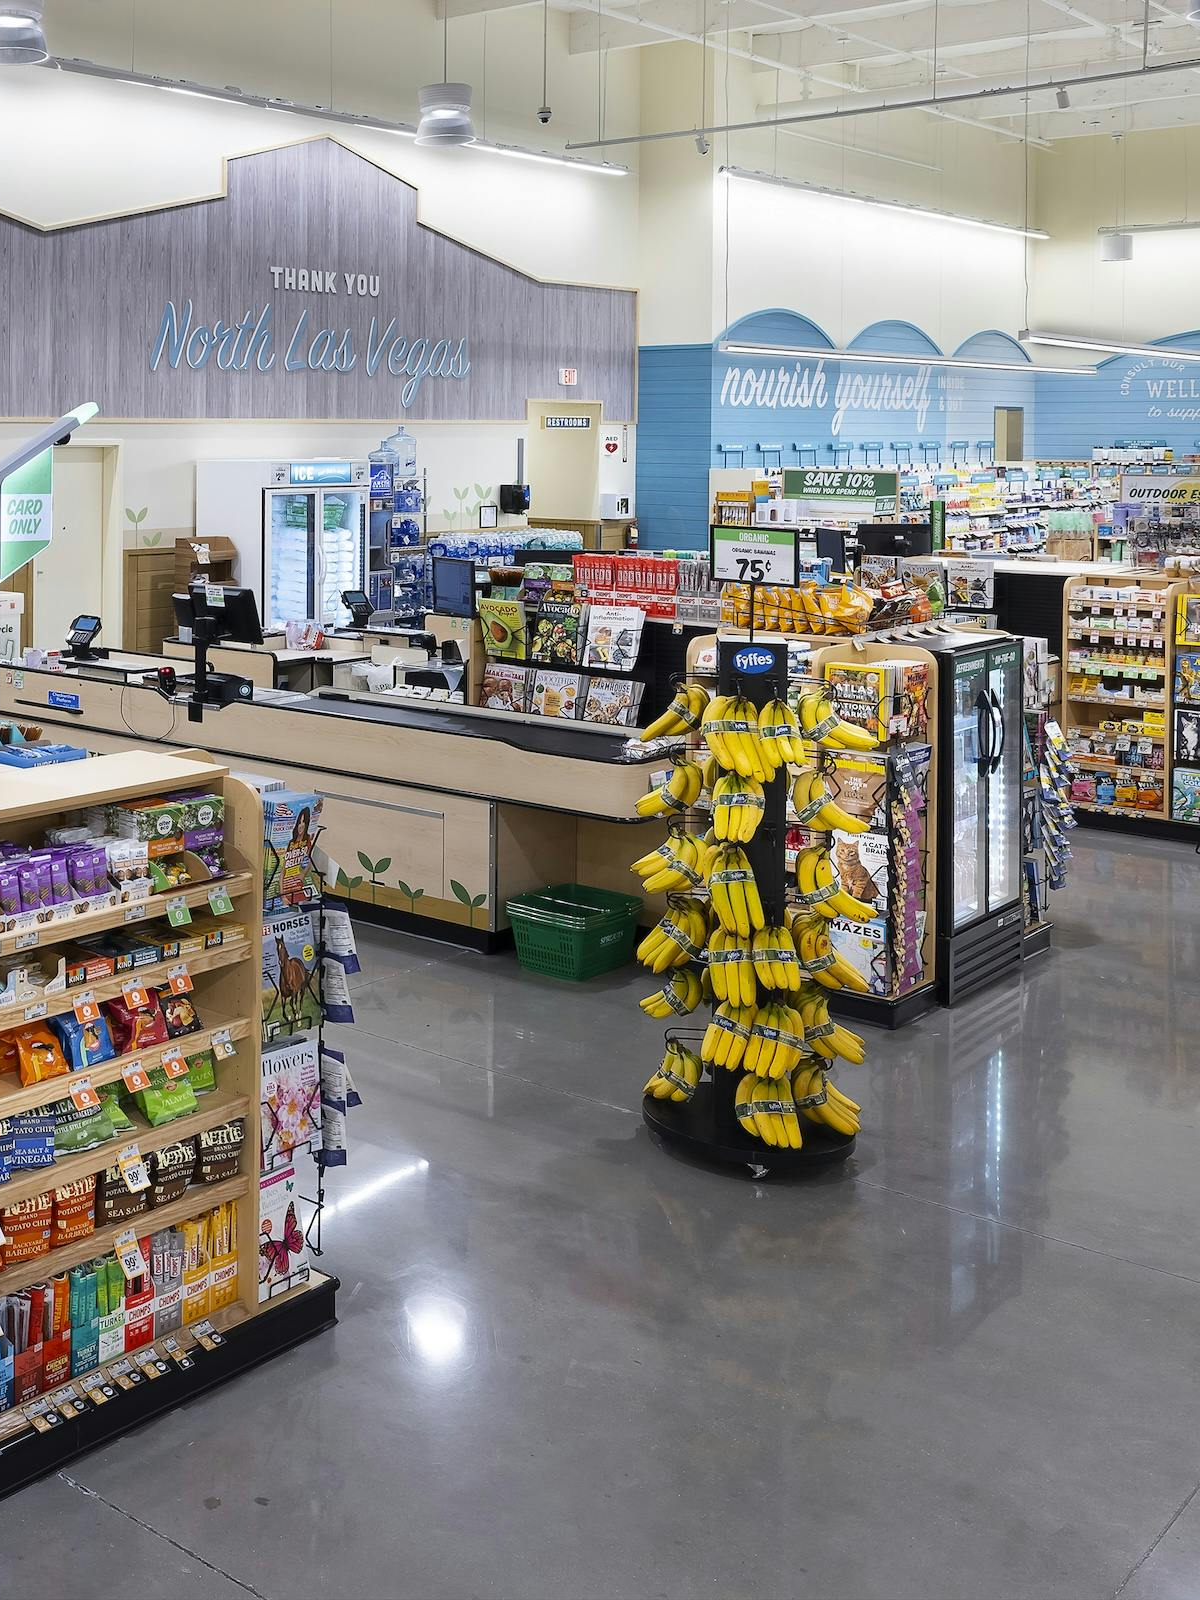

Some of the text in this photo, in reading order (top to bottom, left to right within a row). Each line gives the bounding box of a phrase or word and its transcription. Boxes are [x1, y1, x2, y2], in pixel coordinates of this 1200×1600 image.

[270, 266, 379, 297] THANK YOU
[150, 299, 471, 405] North Las Vegas
[1121, 359, 1184, 395] CONSULT OUR
[721, 359, 932, 436] nourish yourself
[1147, 406, 1161, 417] to
[548, 418, 587, 426] RESTROOMS
[294, 467, 314, 481] ICE
[804, 472, 874, 487] SAVE 10%
[1129, 488, 1187, 498] OUTDOOR
[7, 500, 43, 515] CARD
[9, 518, 41, 534] ONLY
[739, 533, 769, 543] ORGANIC
[481, 604, 517, 613] AVOCADO
[539, 603, 580, 614] Avocado
[735, 652, 772, 669] fyffes
[486, 669, 504, 678] MAKE
[836, 683, 874, 695] ATLAS
[840, 710, 867, 719] PARKS
[844, 780, 868, 788] POWER
[272, 917, 310, 934] HORSES
[830, 921, 882, 939] MAZES
[207, 937, 221, 946] KIND
[163, 949, 177, 957] KIND
[117, 961, 132, 969] KIND
[69, 974, 84, 983] KIND
[261, 1051, 314, 1078] flowers
[200, 1124, 245, 1148] KETTLE
[214, 1144, 232, 1152] BRAND
[11, 1154, 52, 1164] VINEGAR
[156, 1143, 196, 1170] KETTLE
[202, 1153, 226, 1162] POTATO
[205, 1168, 238, 1182] SEA SALT
[156, 1194, 171, 1202] SEA
[19, 1213, 38, 1221] BRAND
[58, 1208, 81, 1216] POTATO
[108, 1203, 146, 1218] SEA SALT
[4, 1222, 31, 1232] POTATO
[57, 1225, 94, 1240] BARBEQUE
[5, 1243, 49, 1257] BARBEQUE
[13, 1239, 44, 1249] BACKYARD
[125, 1255, 137, 1269] 99¢
[214, 1265, 235, 1282] CHOMPS
[187, 1278, 208, 1296] CHOMPS
[159, 1289, 180, 1307] CHOMPS
[129, 1303, 151, 1322] CHOMPS
[100, 1313, 124, 1329] TURKEY
[77, 1344, 96, 1356] TURKEY
